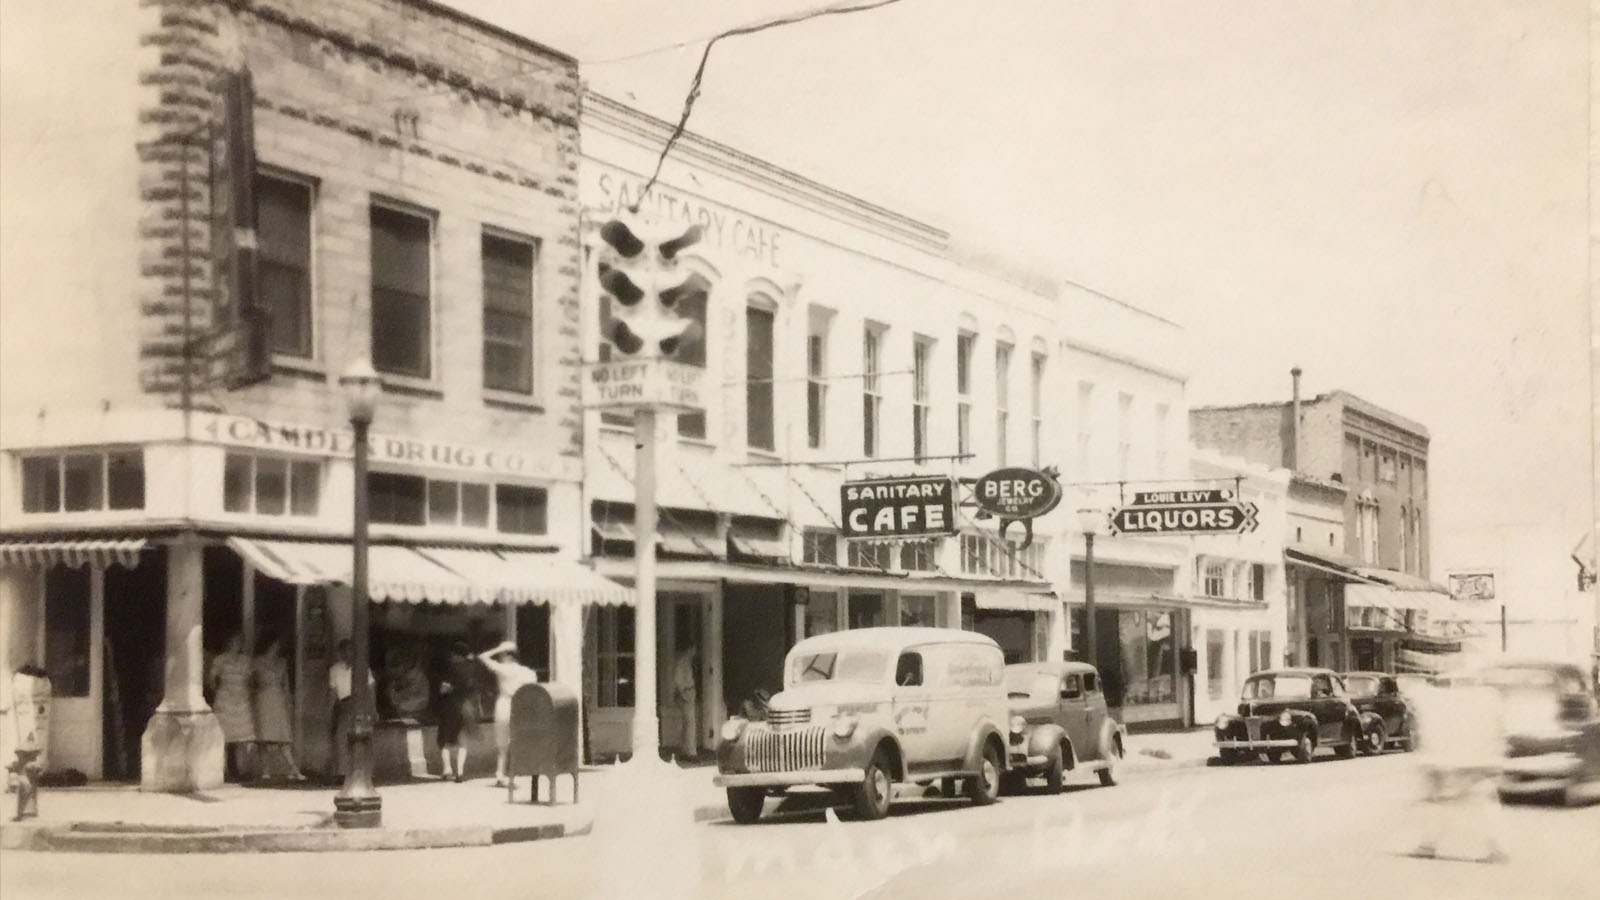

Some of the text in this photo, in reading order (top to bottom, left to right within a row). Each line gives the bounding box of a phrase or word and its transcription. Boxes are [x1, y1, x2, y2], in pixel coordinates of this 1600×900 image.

[733, 219, 781, 268] CAFE
[592, 363, 648, 384] NO LEFT
[599, 383, 643, 400] TURN
[385, 439, 476, 468] DRUG
[847, 483, 945, 500] SANITARY
[984, 479, 1043, 497] BERG
[1144, 491, 1211, 503] LOUIE LEVY
[849, 504, 944, 532] CAFE
[1124, 508, 1235, 532] LIQUORS
